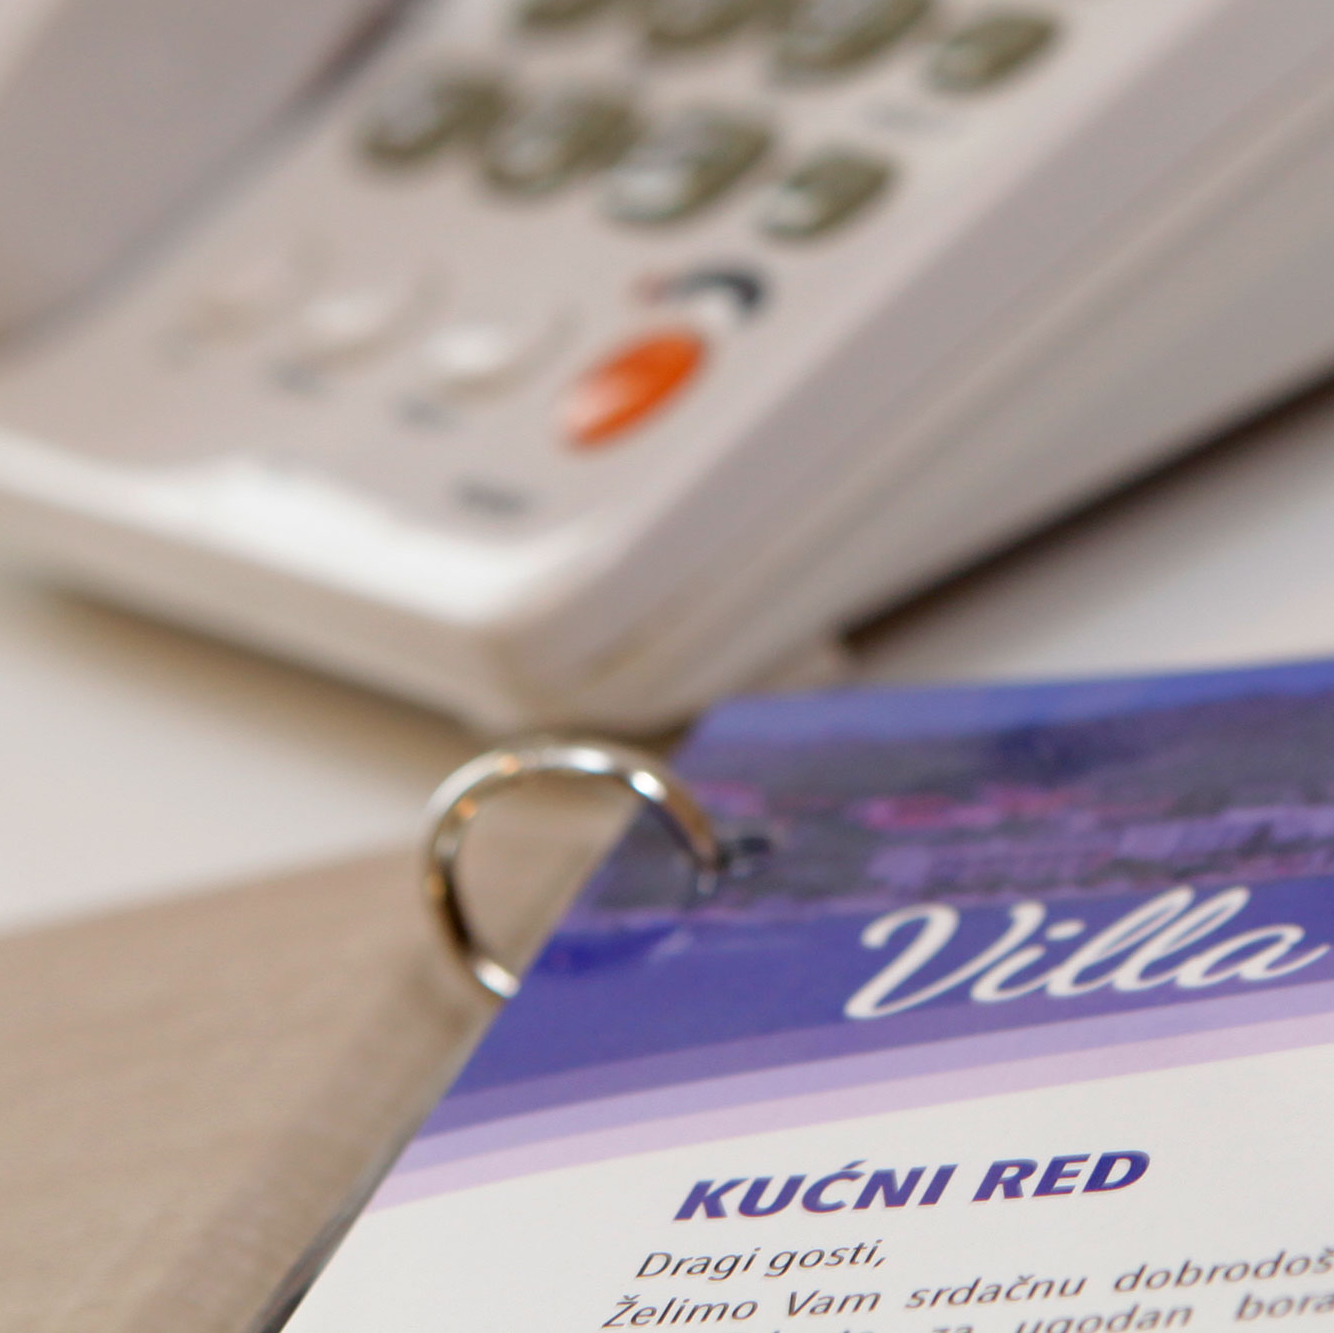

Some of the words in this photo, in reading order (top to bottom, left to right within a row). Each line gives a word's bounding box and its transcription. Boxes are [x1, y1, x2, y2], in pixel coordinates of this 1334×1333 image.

[843, 883, 1331, 1021] Villa
[672, 1159, 962, 1222] KUĆNI
[971, 1149, 1153, 1204] RED
[634, 1246, 762, 1282] Dragi
[763, 1238, 889, 1279] gosti,
[600, 1293, 759, 1330] Želimo
[786, 1288, 881, 1318] Vam
[904, 1274, 1089, 1311] srdačnu
